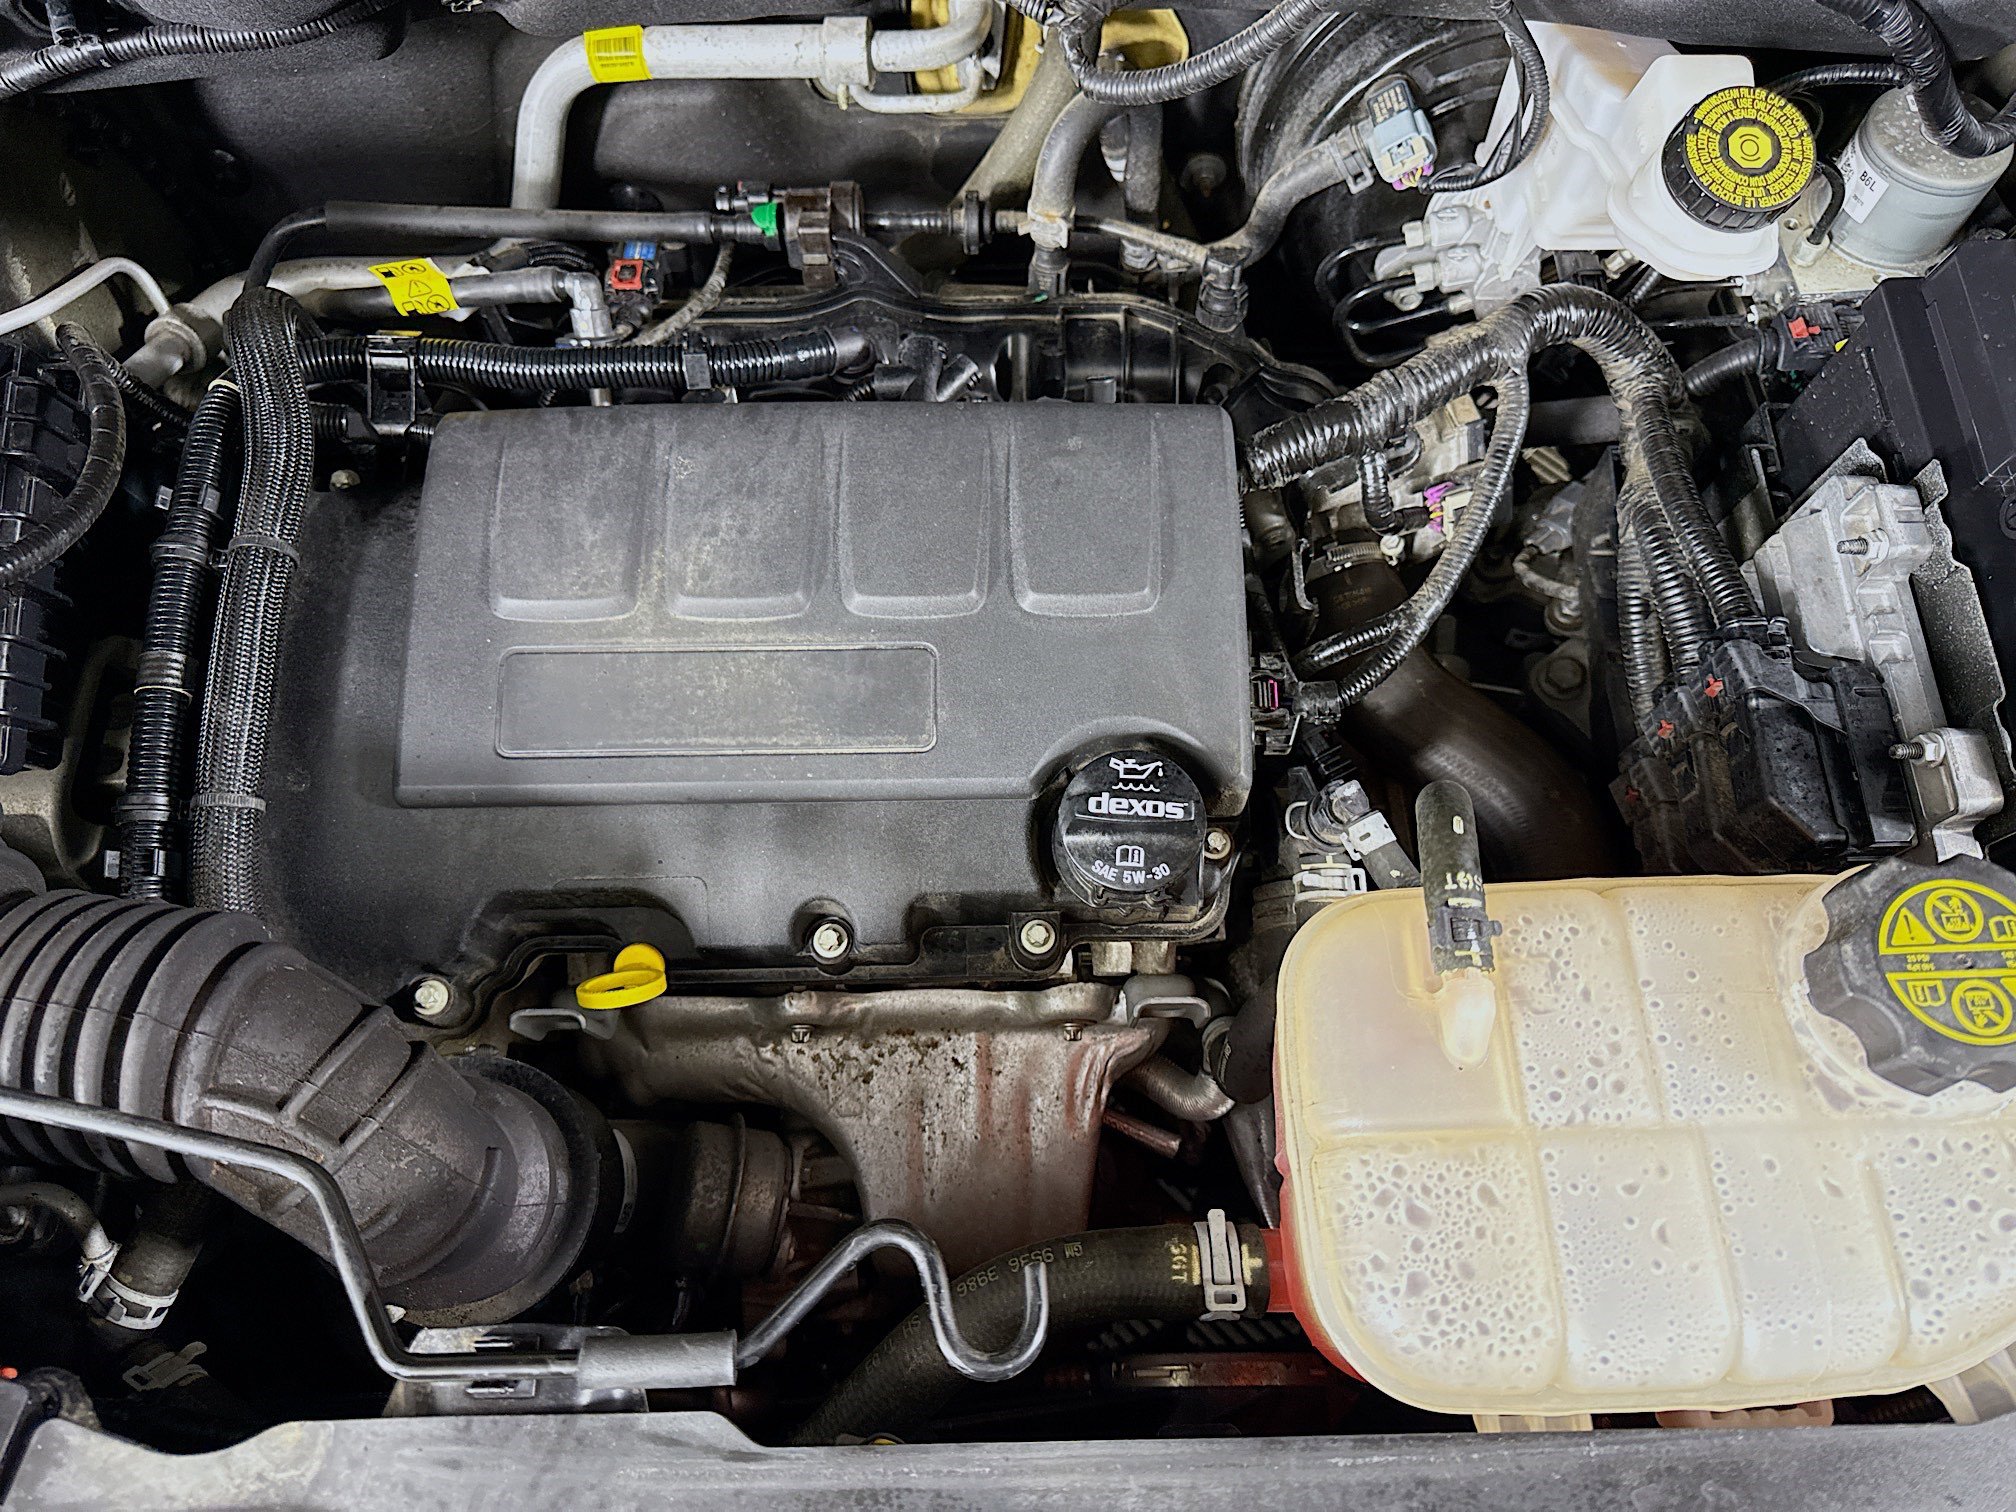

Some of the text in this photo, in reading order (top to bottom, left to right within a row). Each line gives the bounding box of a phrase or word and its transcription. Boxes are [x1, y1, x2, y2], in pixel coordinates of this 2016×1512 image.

[1711, 115, 1730, 134] FROM
[1725, 112, 1734, 122] A
[1732, 108, 1757, 120] SEALED
[1736, 98, 1752, 108] USE
[1754, 98, 1772, 112] ONLY
[1769, 105, 1785, 120] DOT
[1782, 118, 1801, 138] FLUID
[1739, 88, 1767, 100] FILLER
[1767, 92, 1786, 108] CAP
[1783, 103, 1810, 132] BEFORE
[1697, 126, 1710, 153] LIQUIDE
[1792, 137, 1803, 161] AVANT
[1686, 134, 1706, 177] REMPLISSAGE
[1699, 153, 1711, 165] DU
[1765, 153, 1792, 184] PROVENANT
[1789, 162, 1801, 173] DE
[1699, 173, 1714, 187] DE
[1703, 163, 1737, 193] SEULEMENT
[1712, 157, 1748, 186] CONTENANT
[1860, 170, 1876, 191] B6L
[1708, 182, 1743, 206] BOUCHON
[1735, 185, 1766, 197] UTILISER
[1745, 197, 1755, 207] LE
[1088, 792, 1184, 819] dexos
[1091, 860, 1170, 884] SAE 5W-30
[957, 1242, 1082, 1297] GM 9536 3986
